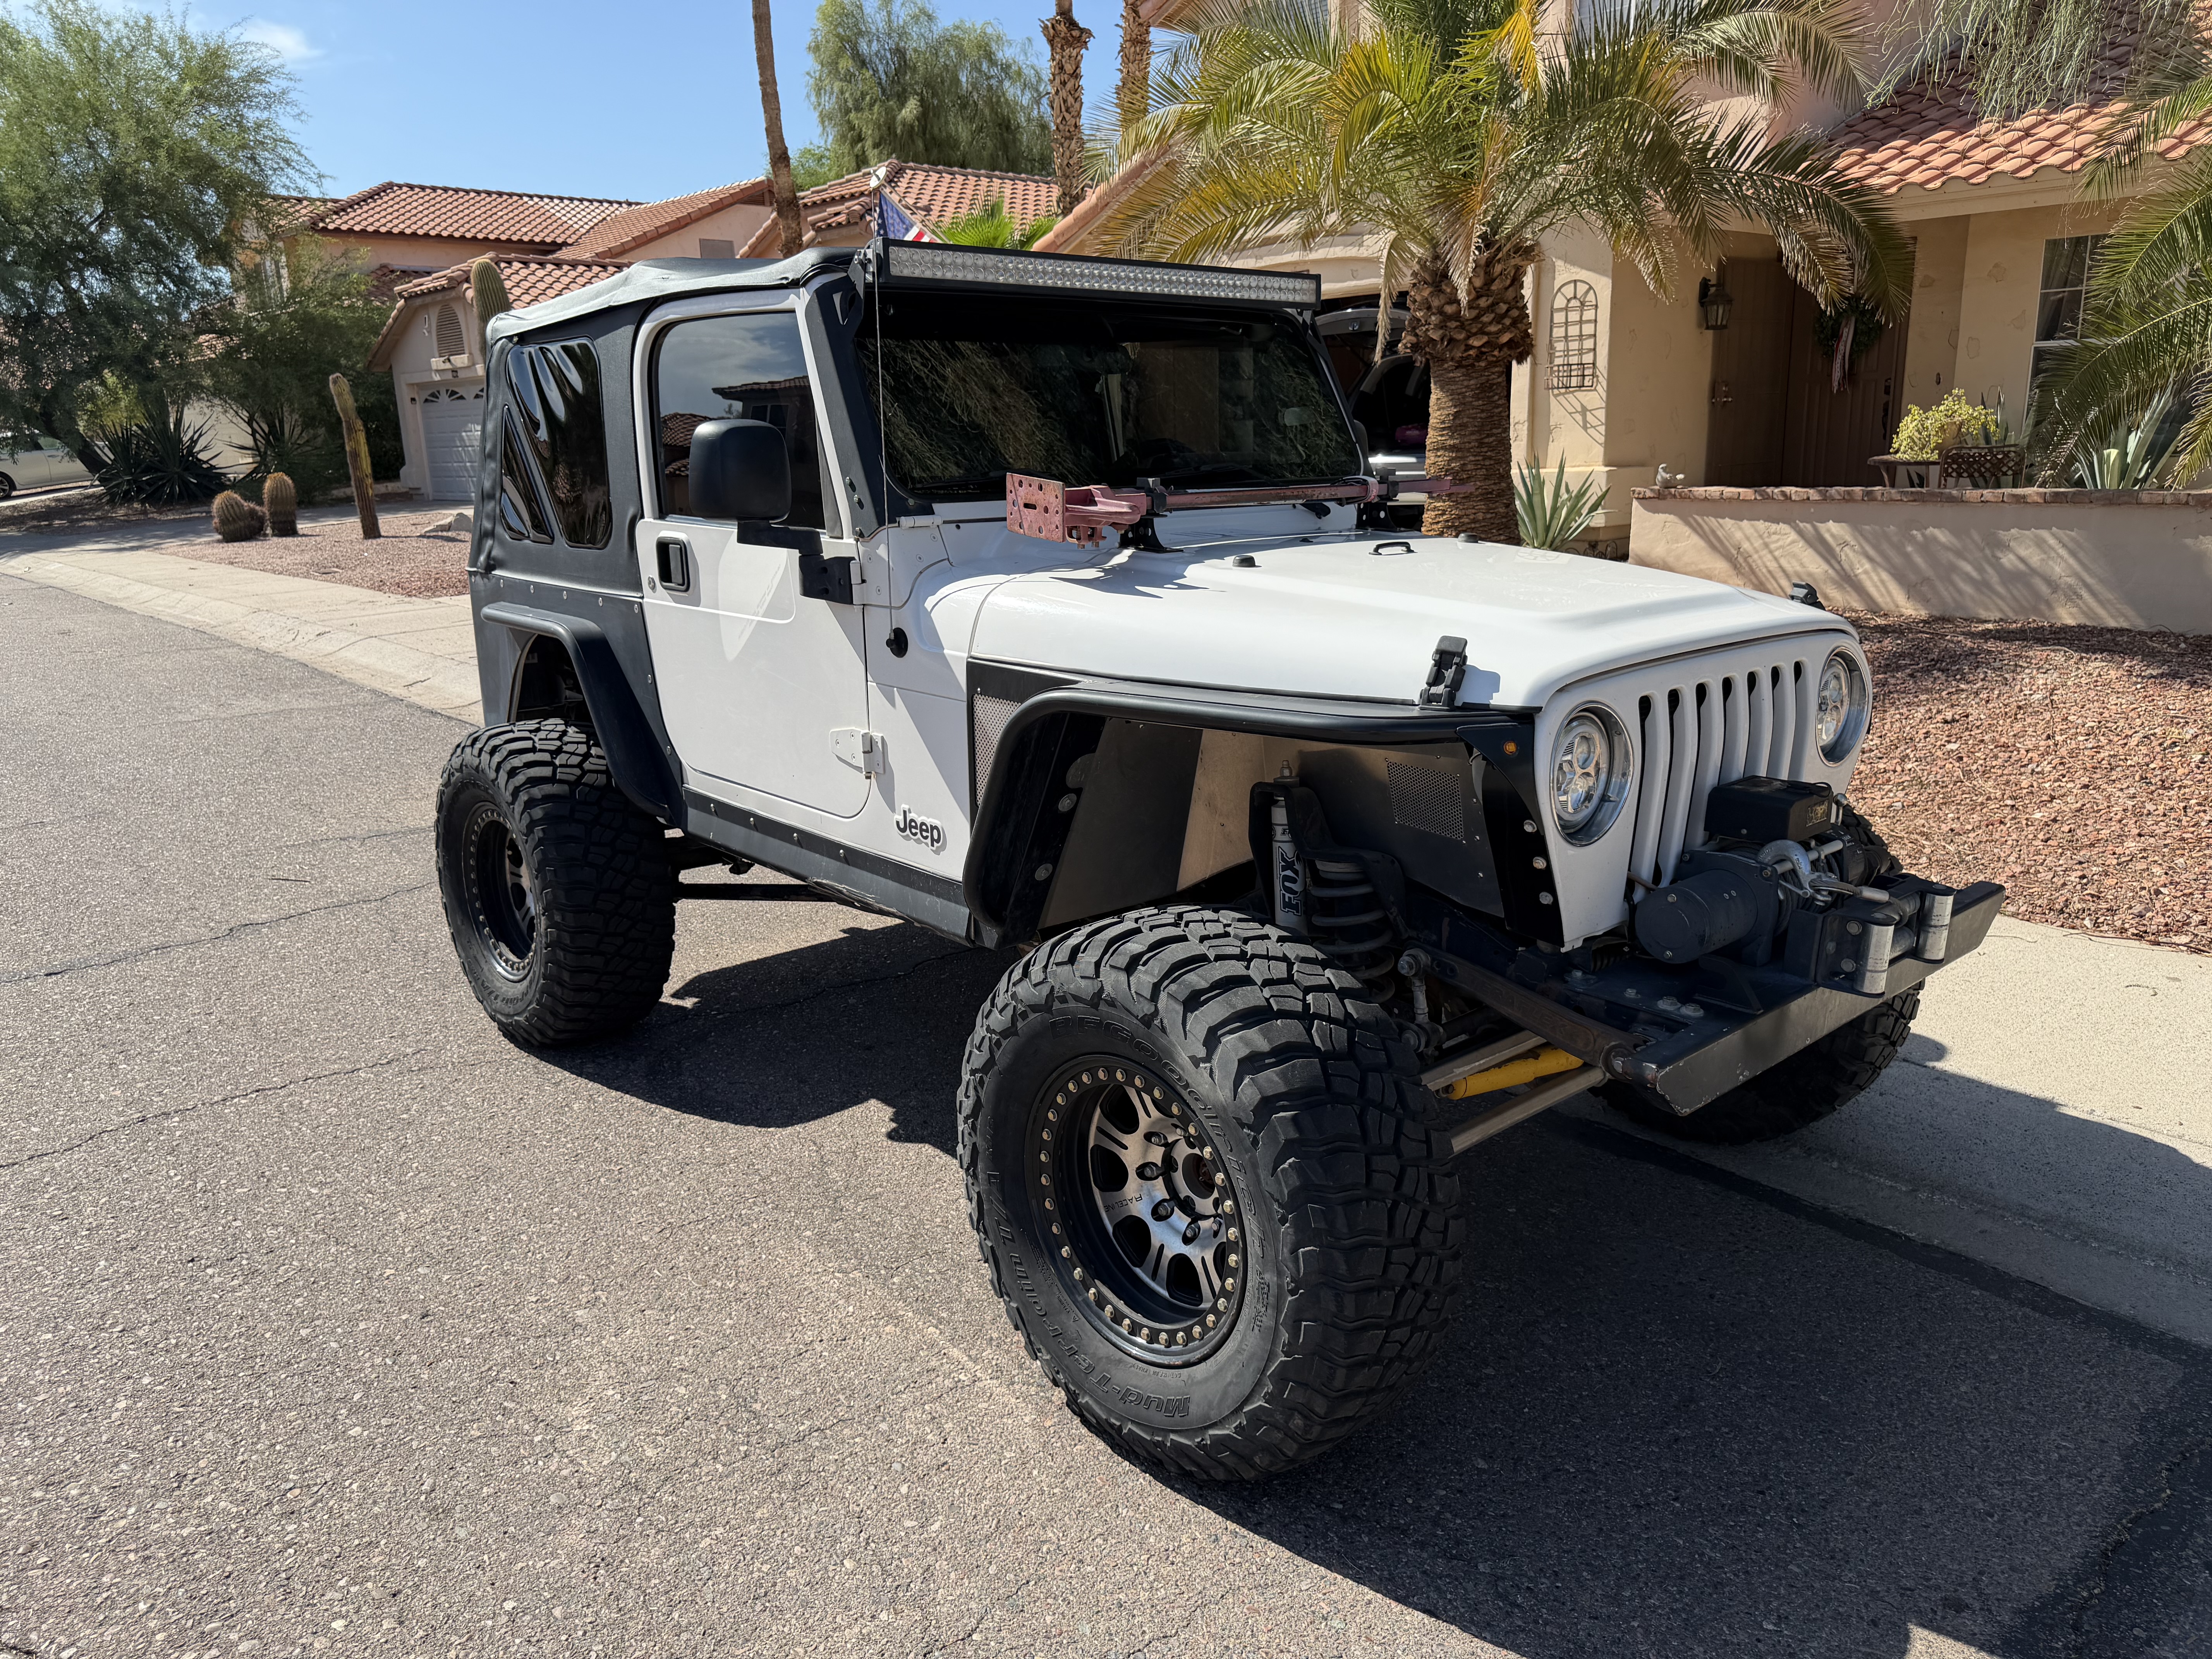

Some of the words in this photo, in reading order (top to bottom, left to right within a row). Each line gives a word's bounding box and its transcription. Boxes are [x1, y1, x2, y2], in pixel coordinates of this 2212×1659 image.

[895, 808, 942, 848] Jeep
[1278, 846, 1302, 916] FOX
[987, 1171, 1015, 1245] T/A
[1104, 1194, 1142, 1212] RACELINE
[1008, 1252, 1191, 1419] Mud-Terrain
